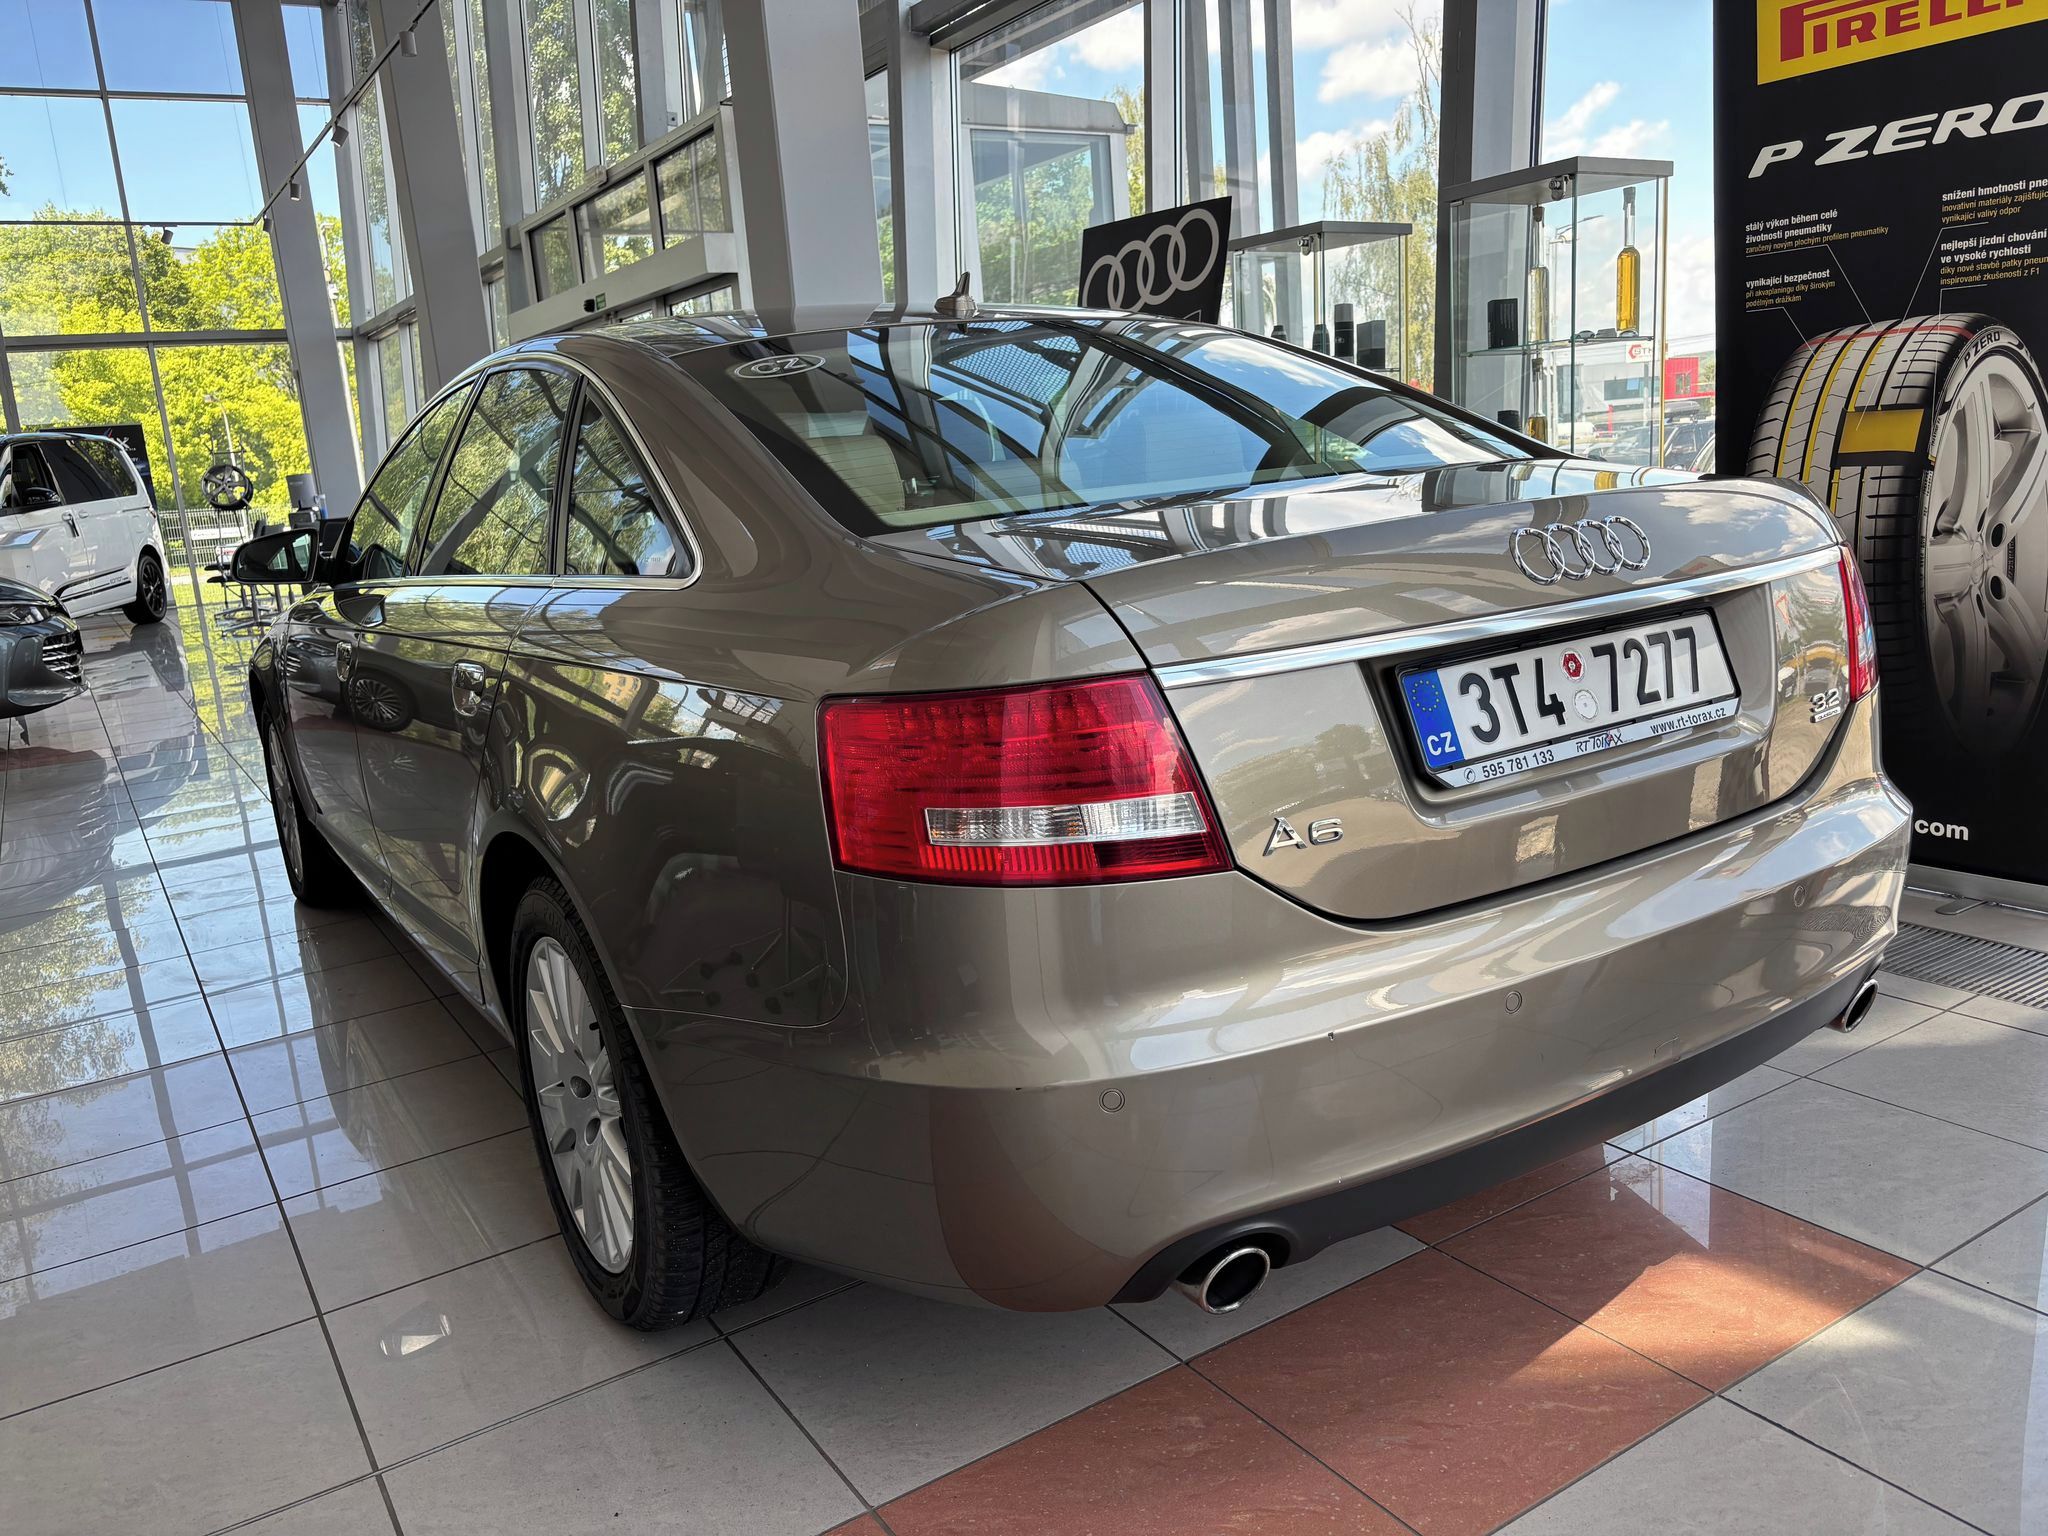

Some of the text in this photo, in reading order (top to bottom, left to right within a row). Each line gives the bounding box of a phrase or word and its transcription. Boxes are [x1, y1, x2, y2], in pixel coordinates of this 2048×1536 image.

[1780, 0, 2024, 62] PIRELL
[1748, 91, 2048, 178] P ZERO
[1942, 187, 1976, 202] snížení
[1978, 180, 2026, 196] hmotnosti
[1941, 200, 1977, 212] inovativní
[1978, 194, 2012, 207] materiály
[1745, 208, 1838, 232] stálý výkon během celé
[1941, 206, 2021, 224] vynikající valivý odpor
[1745, 224, 1832, 244] životnosti pneumatiky
[1794, 236, 1821, 248] plochým
[1822, 231, 1849, 243] profilem
[1850, 226, 1889, 239] pneumatiky
[1940, 227, 2048, 252] nejlepší jízdní chování
[1940, 244, 2032, 264] ve vysoké rychlosti
[1940, 265, 1956, 276] díky
[1956, 262, 1975, 273] nové
[1975, 260, 2000, 271] stavbě
[2001, 257, 2022, 270] patky
[1940, 274, 1982, 286] inspirované
[1982, 268, 2022, 282] zkušenosti
[2030, 266, 2040, 276] F1
[1745, 268, 1830, 289] vynikající bezpečnost
[1963, 331, 2001, 369] P ZERO
[751, 357, 808, 374] CZ
[1458, 626, 1700, 744] 3T4 7277
[1650, 707, 1727, 735] www.rt-torax.cz
[1426, 729, 1457, 757] CZ
[1576, 740, 1590, 753] RT
[1482, 749, 1555, 778] 595 781 133
[1262, 816, 1344, 857] A6
